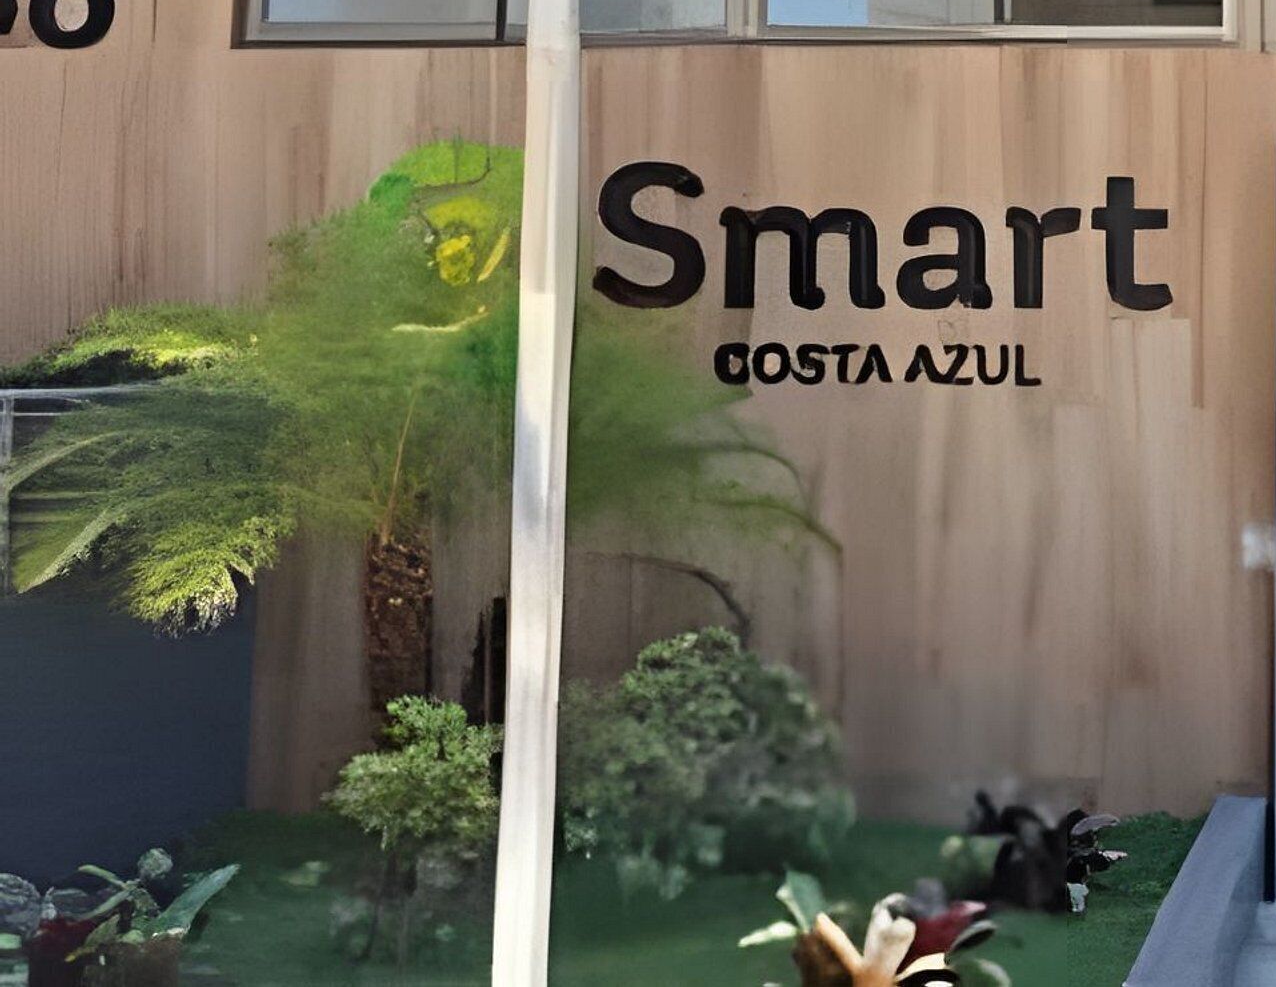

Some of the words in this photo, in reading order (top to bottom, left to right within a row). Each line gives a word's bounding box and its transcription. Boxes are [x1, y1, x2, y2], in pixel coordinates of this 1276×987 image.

[592, 160, 1173, 311] Smart
[714, 342, 893, 385] COSTA
[903, 343, 1042, 387] AZUL
